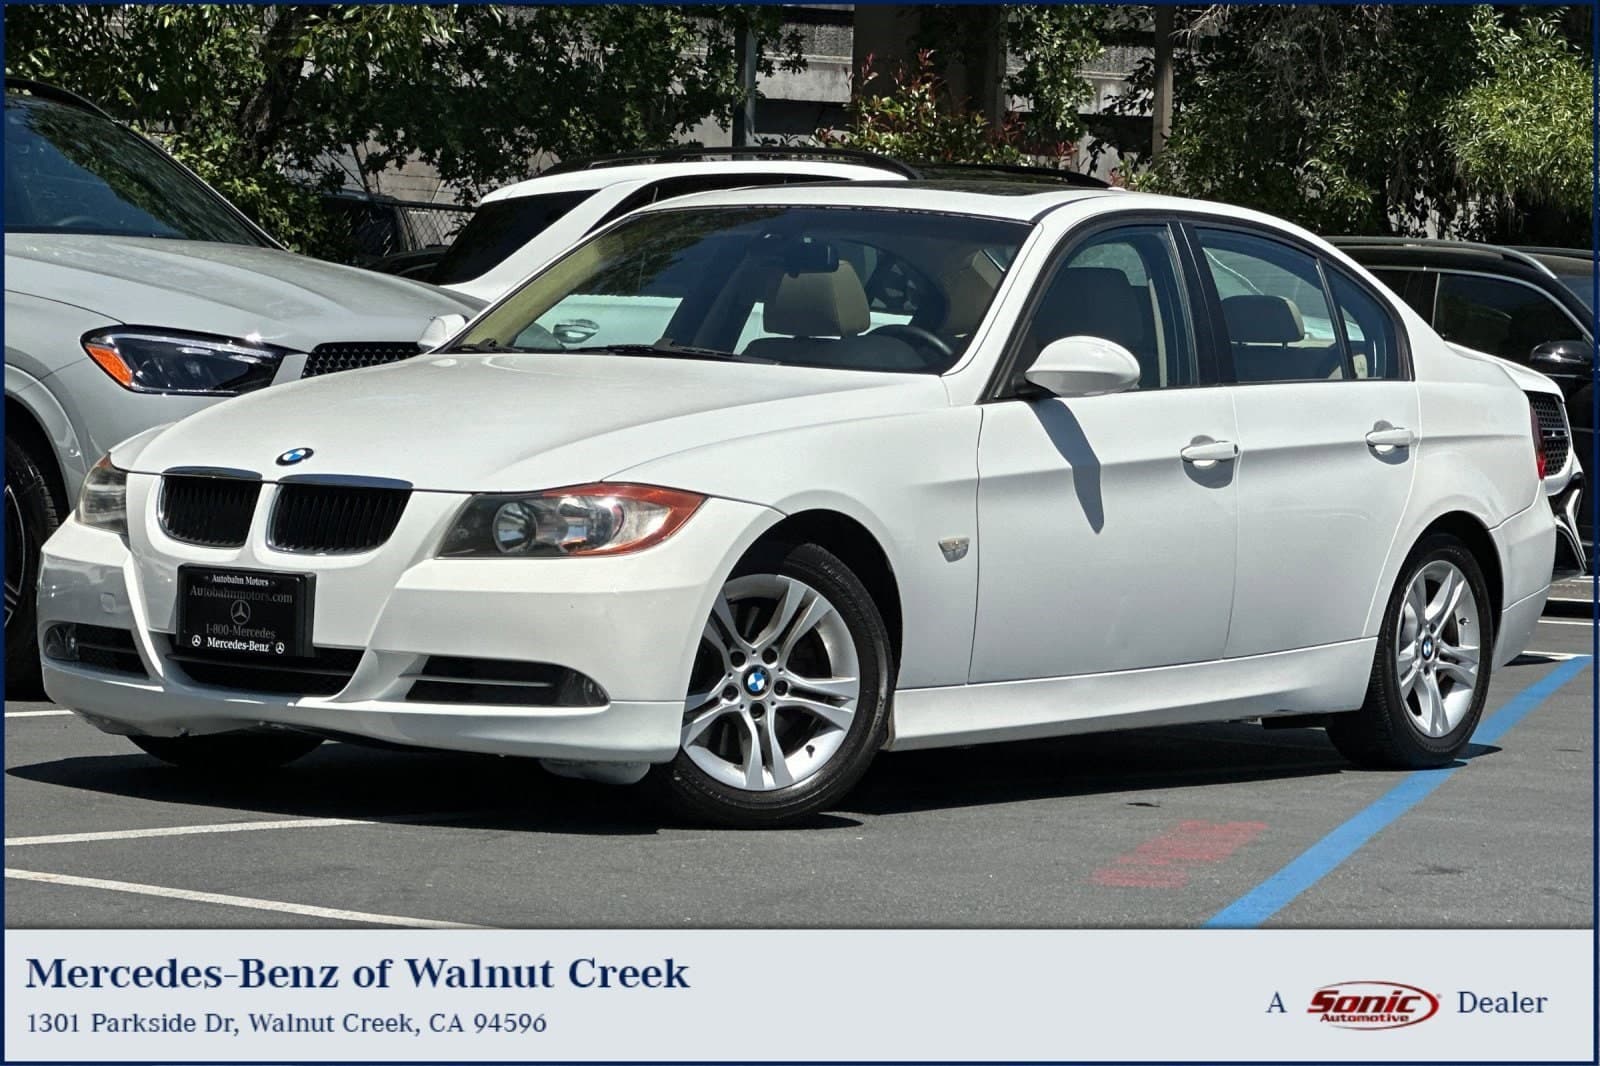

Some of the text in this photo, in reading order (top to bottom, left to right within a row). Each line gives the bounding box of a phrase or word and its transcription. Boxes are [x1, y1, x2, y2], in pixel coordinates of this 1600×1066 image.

[211, 574, 270, 587] Autobahn Motors
[190, 584, 293, 604] Autobahnmotors.com
[205, 623, 276, 639] 1-800-Mercedes
[207, 636, 270, 652] Mercedes-Benz
